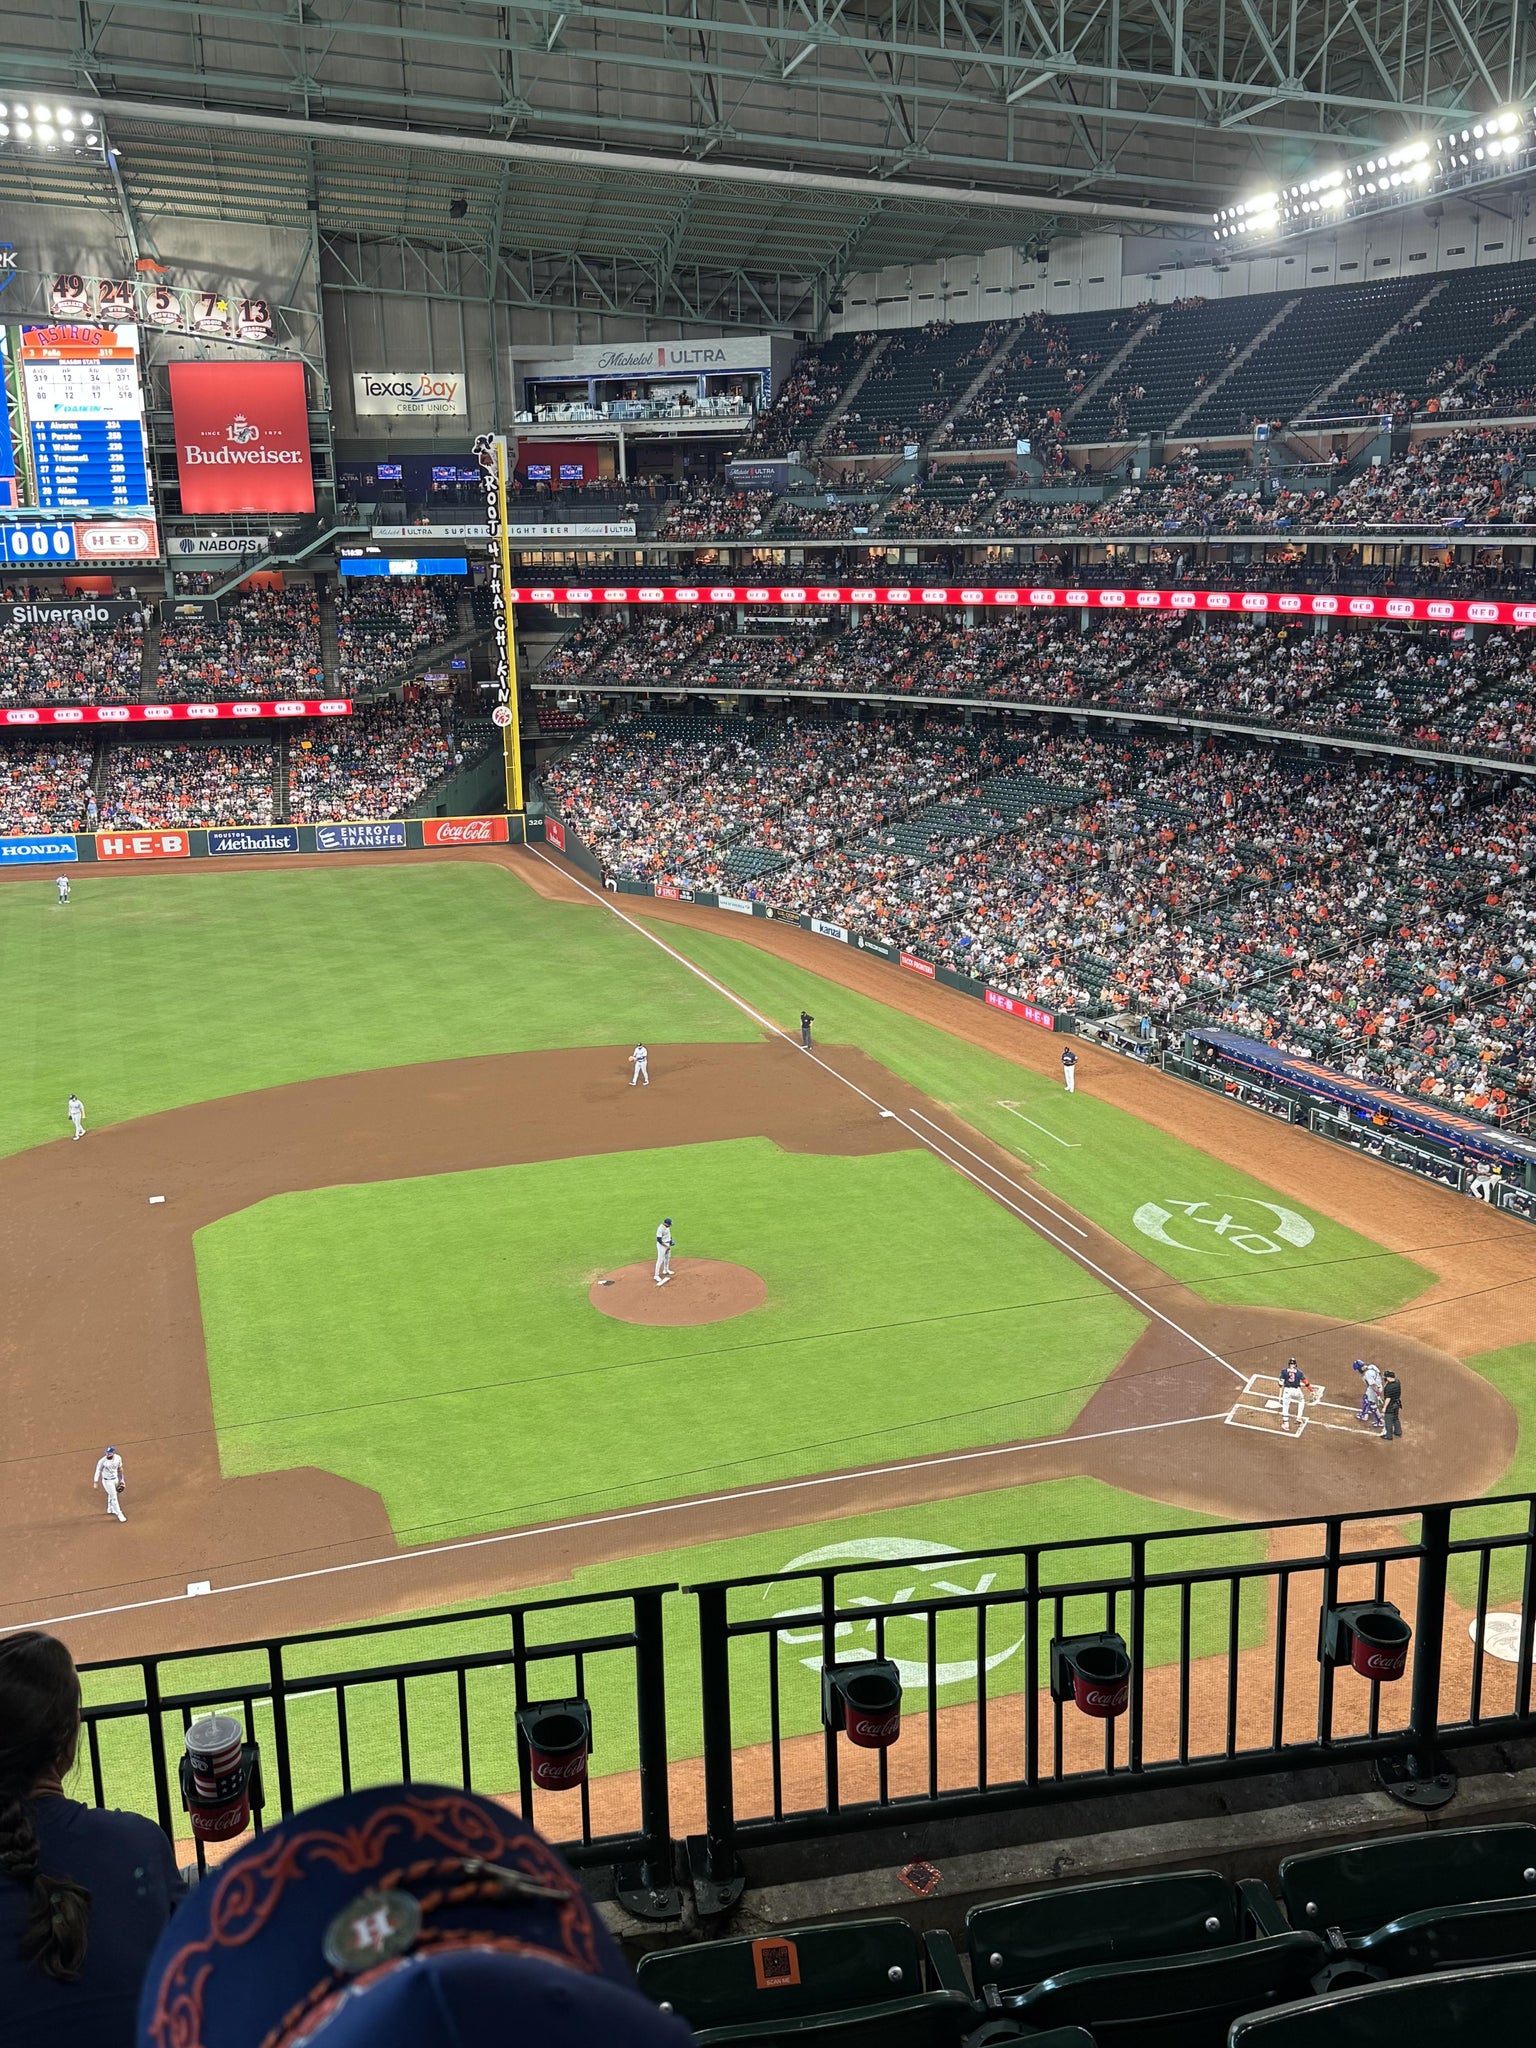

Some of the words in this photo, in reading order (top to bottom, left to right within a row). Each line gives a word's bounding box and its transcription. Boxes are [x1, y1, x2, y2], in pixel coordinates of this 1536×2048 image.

[53, 274, 84, 298] 49
[99, 279, 131, 303] 24
[155, 286, 170, 310] 5
[201, 293, 217, 317] 7
[240, 299, 270, 323] 13
[37, 325, 103, 346] ASTROS
[598, 351, 654, 369] Michelob
[670, 348, 727, 364] ULTRA
[361, 376, 414, 397] Texas
[420, 376, 458, 403] Bay
[397, 403, 424, 412] CREDIT
[428, 403, 456, 412] UNION
[11, 531, 29, 556] 0
[31, 530, 49, 555] 0
[52, 530, 71, 555] 0
[199, 539, 257, 551] NABORS
[488, 541, 500, 557] 4
[12, 603, 110, 623] Silverado
[340, 825, 391, 837] ENERGY
[341, 835, 404, 847] TRANSFER
[1, 844, 76, 856] HONDA
[102, 836, 183, 855] H-E-B
[205, 834, 291, 851] Methodist
[1283, 1060, 1377, 1090] ASTROS
[1366, 1090, 1487, 1131] HOUSTON
